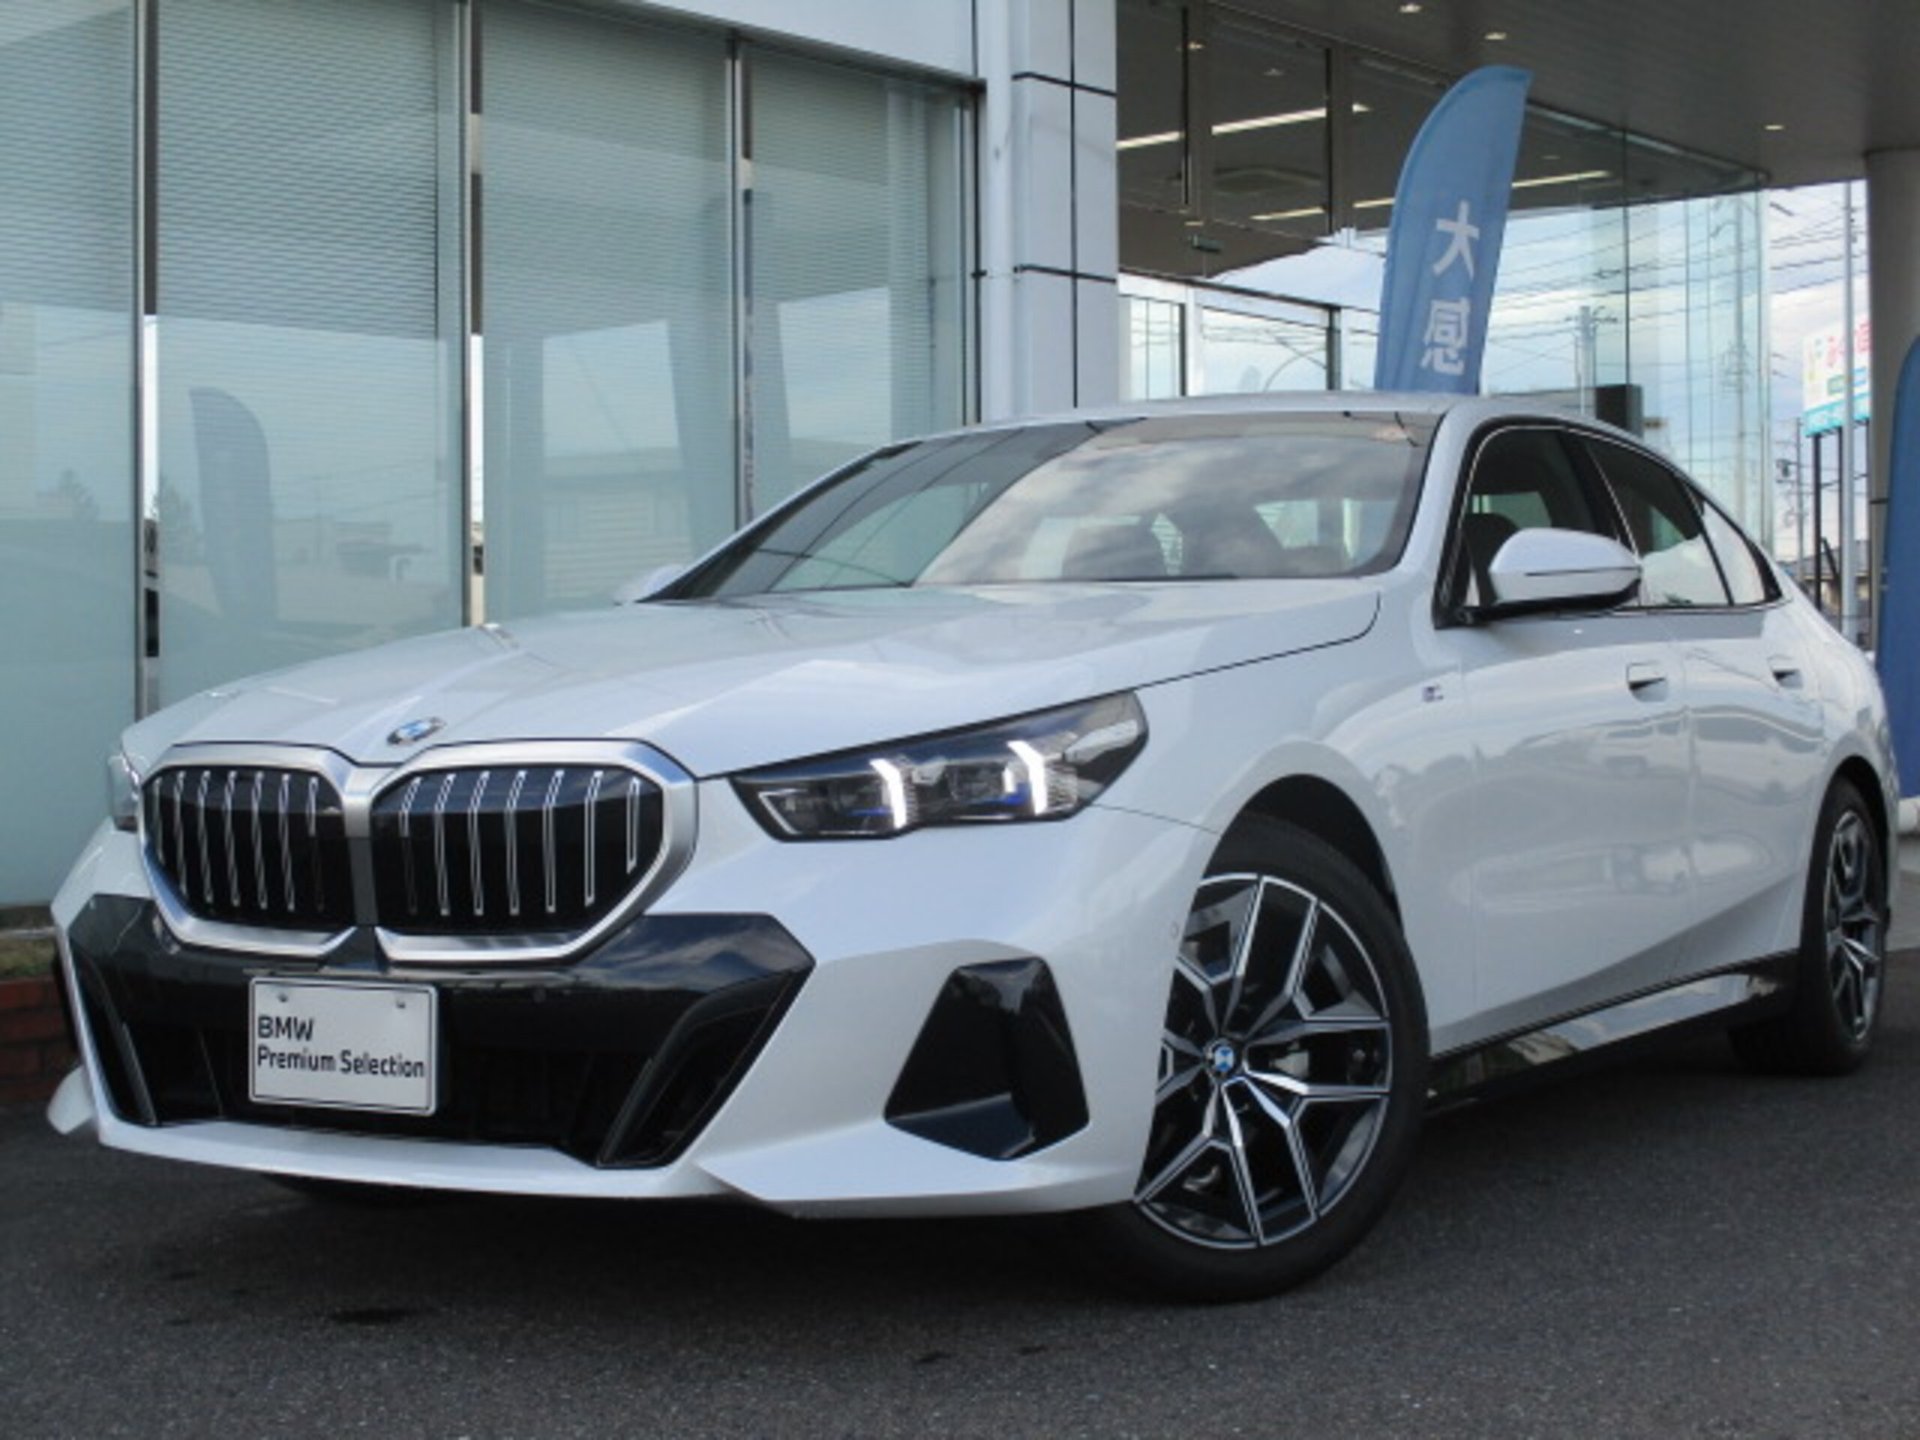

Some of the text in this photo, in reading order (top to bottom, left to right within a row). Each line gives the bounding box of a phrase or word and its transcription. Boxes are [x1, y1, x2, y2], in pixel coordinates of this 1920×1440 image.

[257, 1016, 314, 1041] BMW
[257, 1045, 425, 1078] Premium Selection
